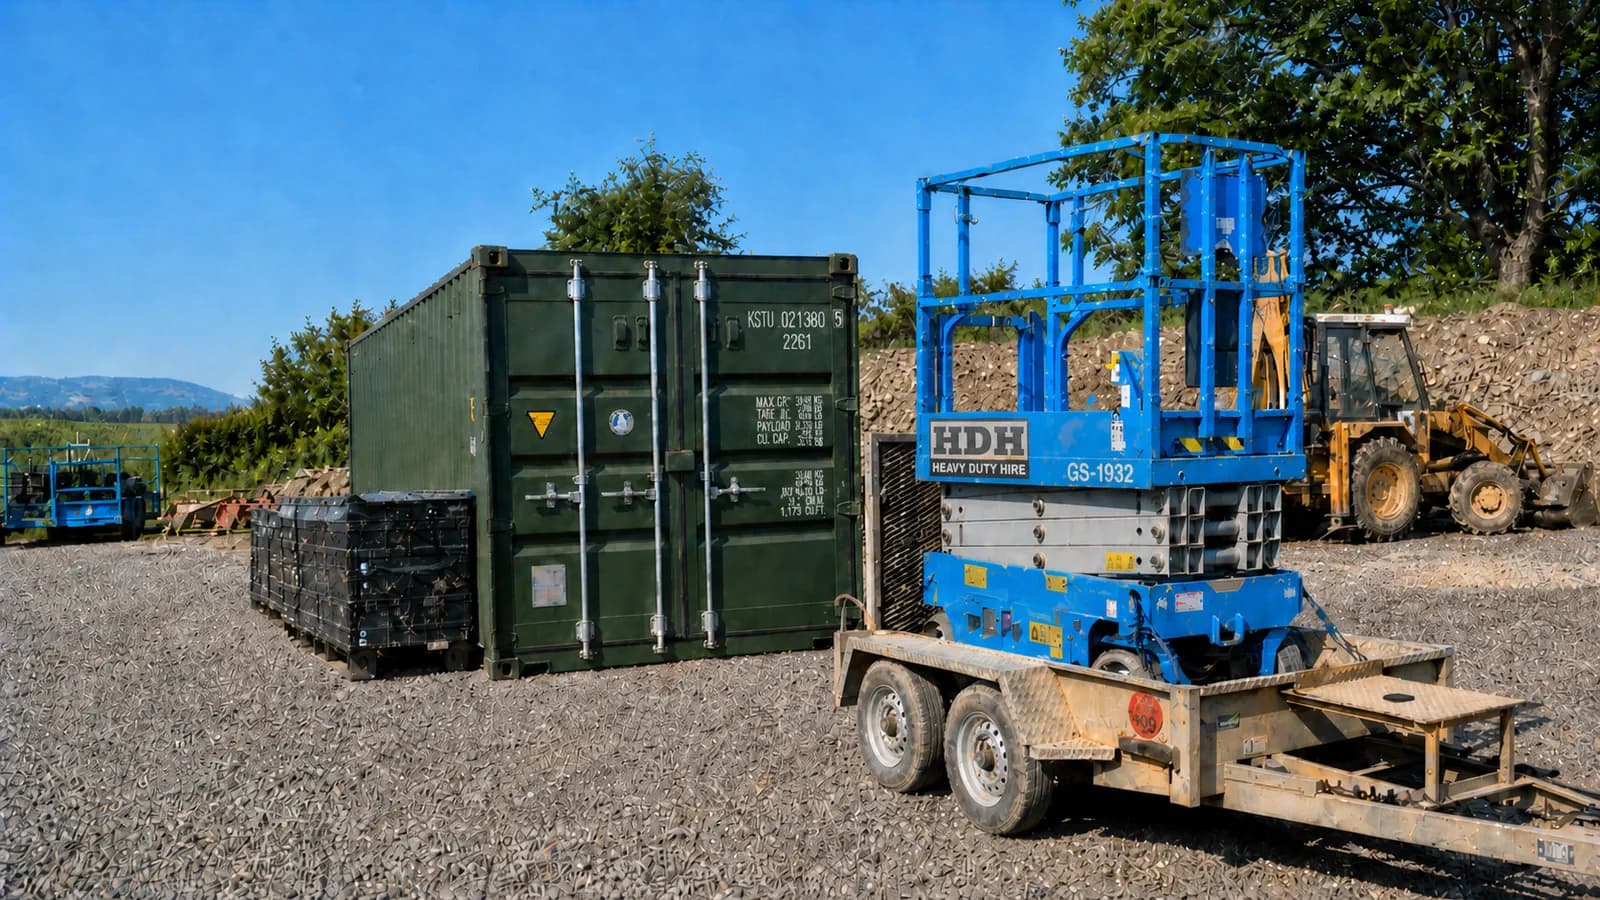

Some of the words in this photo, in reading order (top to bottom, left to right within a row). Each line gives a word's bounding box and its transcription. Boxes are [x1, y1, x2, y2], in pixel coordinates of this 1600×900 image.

[747, 310, 775, 328] KSTU
[781, 310, 826, 328] 021380
[834, 310, 843, 328] 5
[783, 333, 811, 350] 2261
[756, 420, 791, 432] PAYLOAD
[933, 426, 1025, 456] HDH
[932, 462, 966, 474] HEAVY
[968, 463, 998, 474] DUTY
[1000, 464, 1026, 476] HIRE
[1067, 462, 1134, 483] GS-1932
